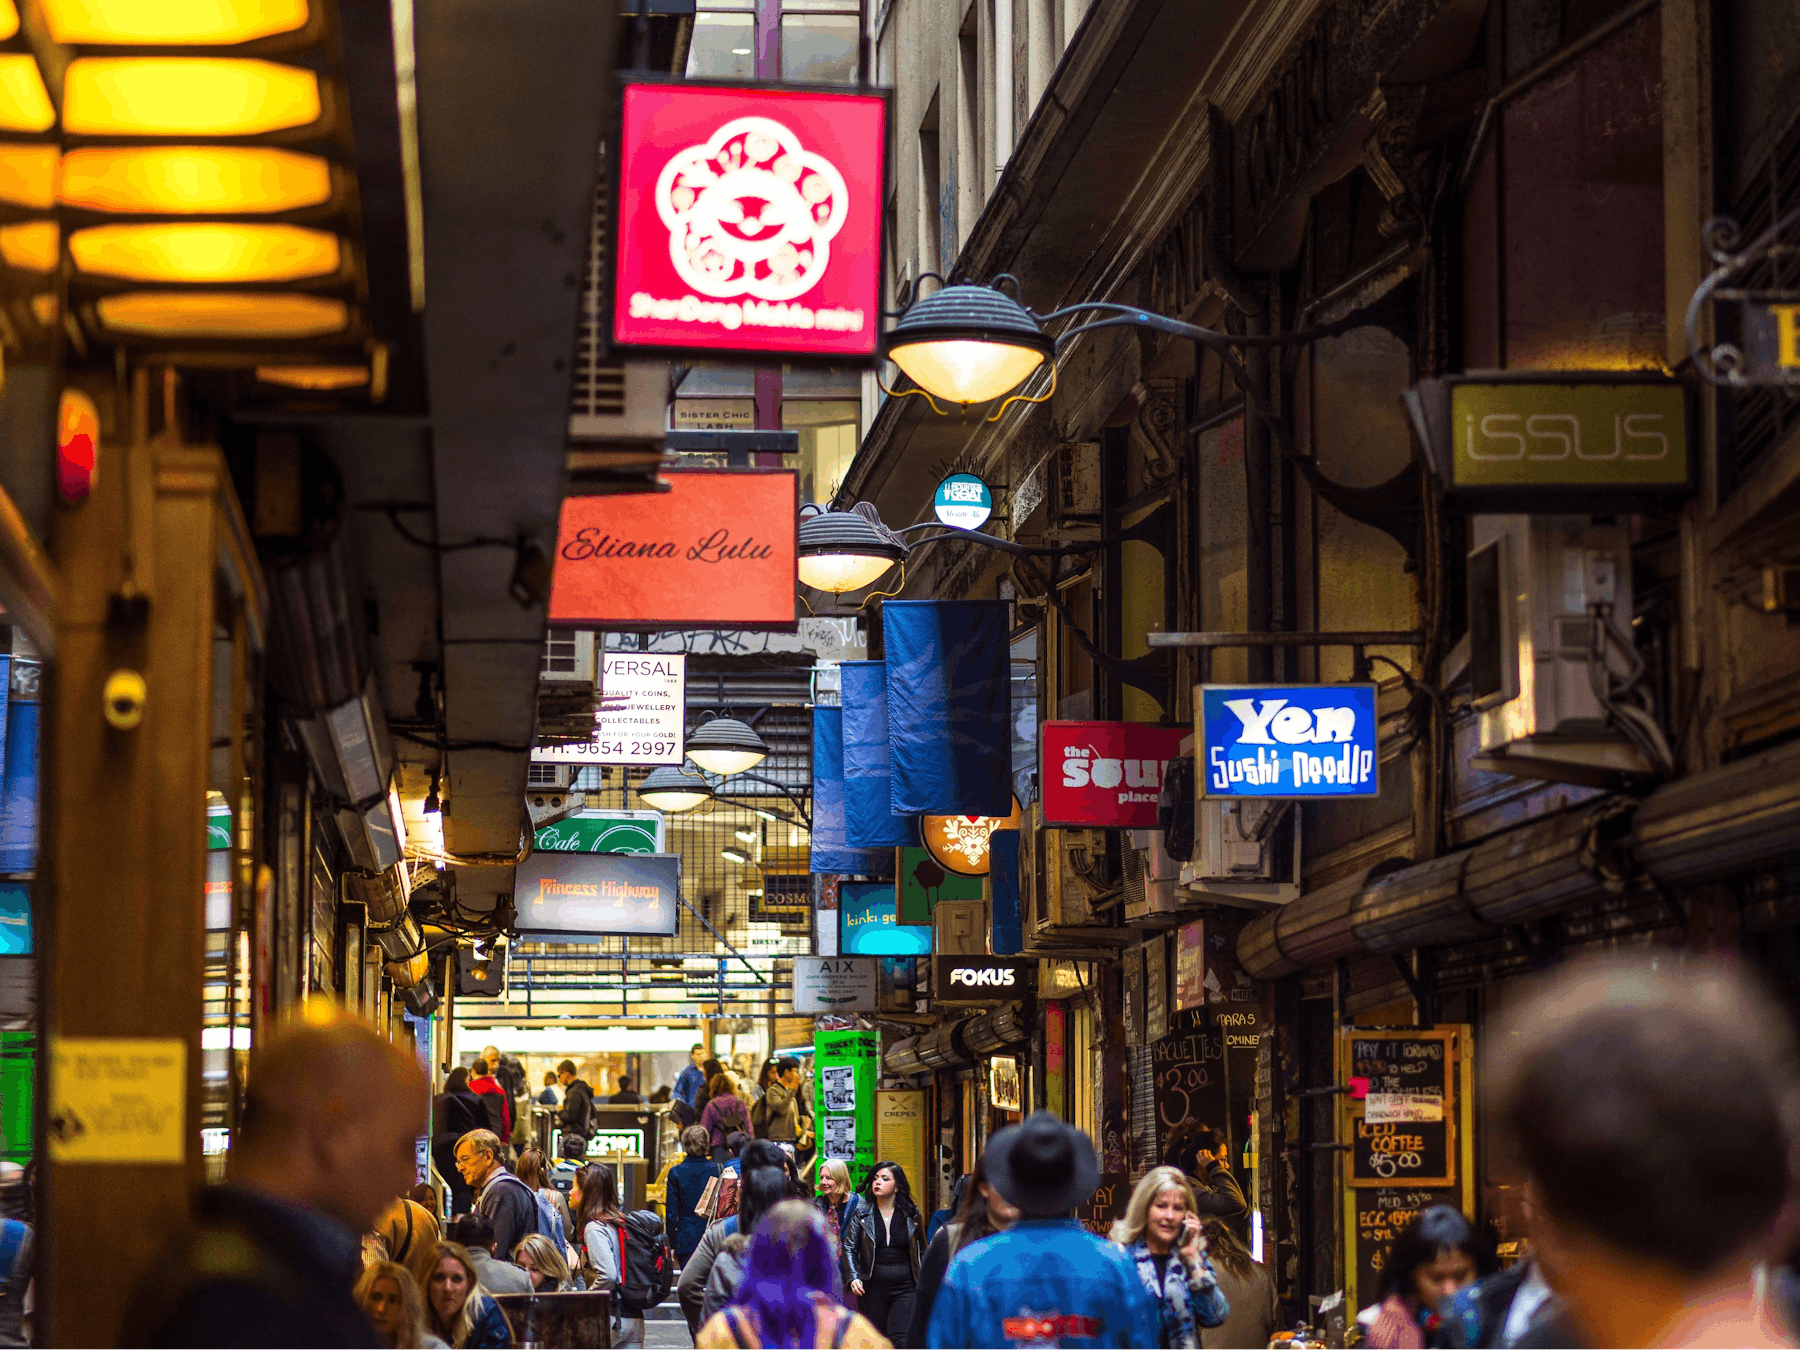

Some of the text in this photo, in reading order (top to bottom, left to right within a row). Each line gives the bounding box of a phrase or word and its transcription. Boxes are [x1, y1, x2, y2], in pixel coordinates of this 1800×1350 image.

[680, 411, 750, 419] SISTER CHIC
[697, 422, 733, 430] LASH
[951, 489, 982, 502] GOAT
[561, 528, 773, 564] Eliana Lulu
[642, 690, 671, 698] COINS,
[596, 717, 661, 725] COLLECTABLES
[1222, 698, 1356, 745] Yen
[577, 741, 624, 755] 9654
[630, 741, 676, 756] 2997
[1063, 746, 1090, 758] the
[1211, 746, 1280, 789] Sushi
[1118, 791, 1159, 804] place
[534, 826, 581, 851] Cafe
[533, 878, 660, 909] Princess Highway
[846, 909, 878, 927] kinki
[820, 961, 854, 973] AIX
[950, 968, 1015, 987] FOKUS
[1401, 1061, 1428, 1074] HELP
[1382, 1076, 1400, 1087] THE
[1358, 1120, 1396, 1138] ICED
[1371, 1135, 1425, 1154] COFFEE
